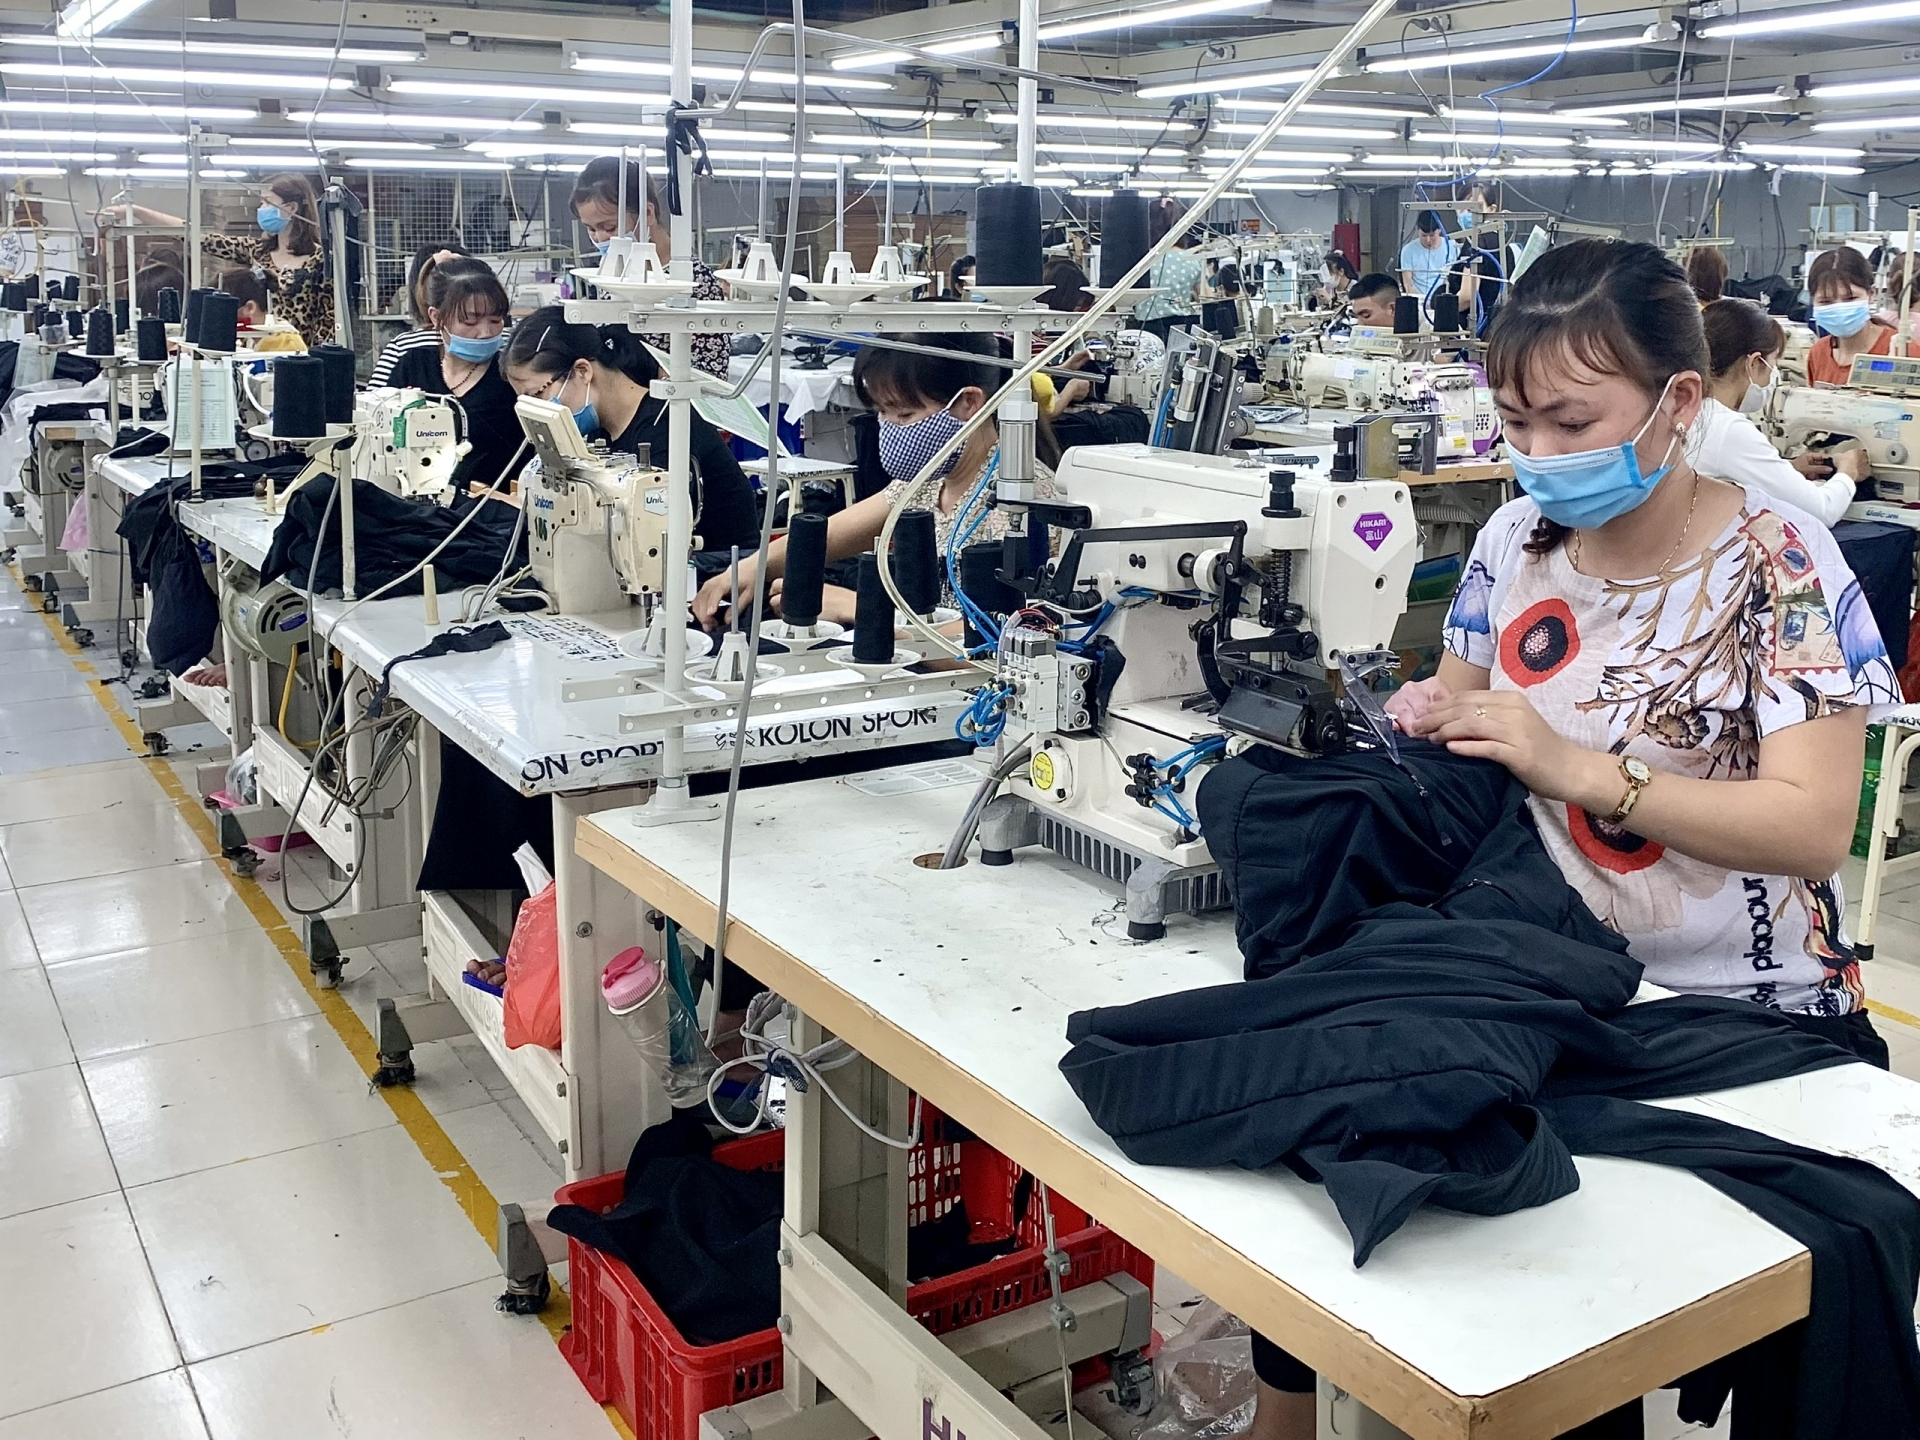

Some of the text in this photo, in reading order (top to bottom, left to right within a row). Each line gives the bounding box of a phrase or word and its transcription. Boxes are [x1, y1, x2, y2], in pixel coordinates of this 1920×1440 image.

[1359, 518, 1387, 529] HIKARI
[1364, 528, 1384, 541] 富山
[759, 716, 851, 747] KOLON
